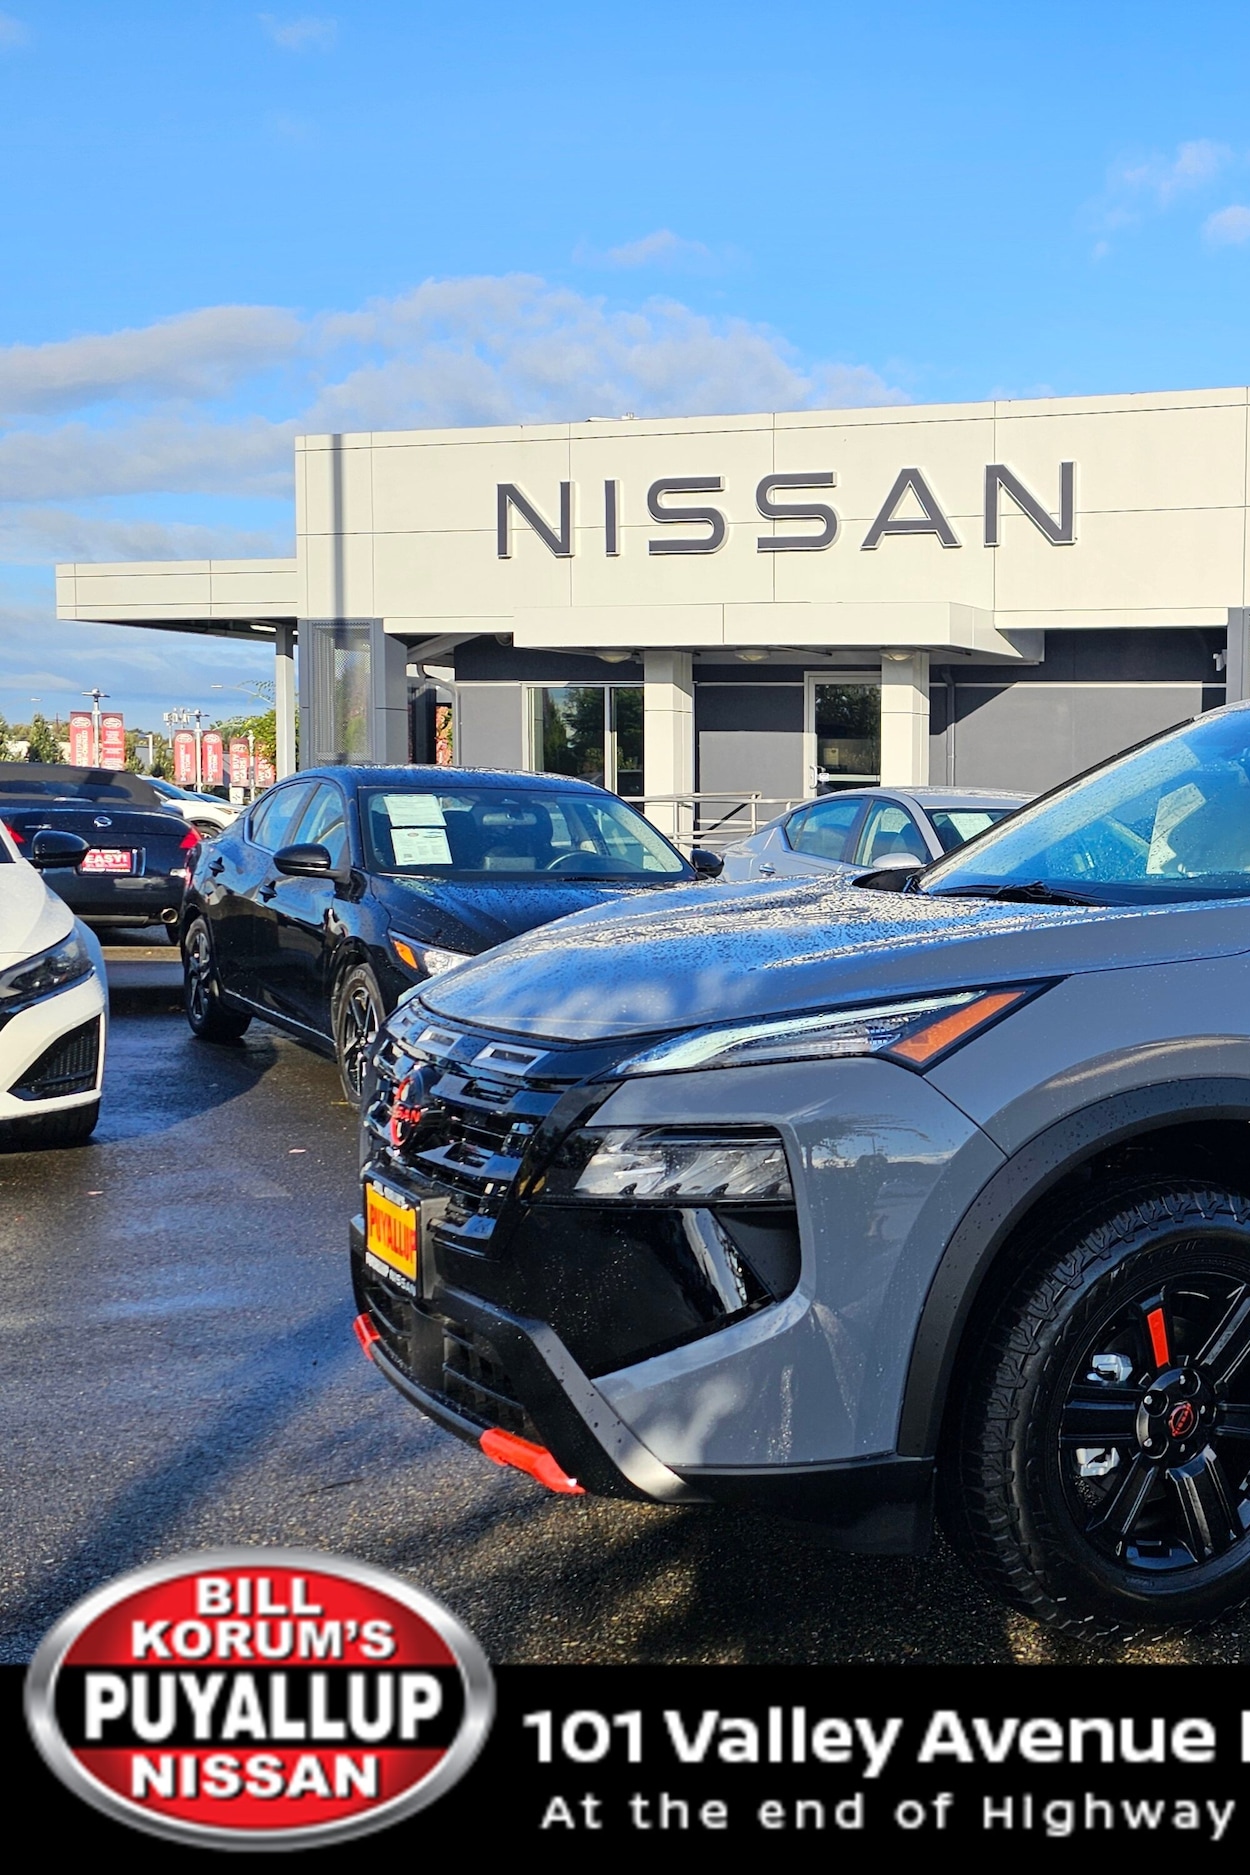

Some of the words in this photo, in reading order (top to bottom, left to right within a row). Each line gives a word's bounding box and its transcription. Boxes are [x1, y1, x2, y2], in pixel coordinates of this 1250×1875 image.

[497, 461, 1077, 559] NISSAN
[84, 854, 128, 864] EASY!
[369, 1203, 416, 1264] PUYALLUP
